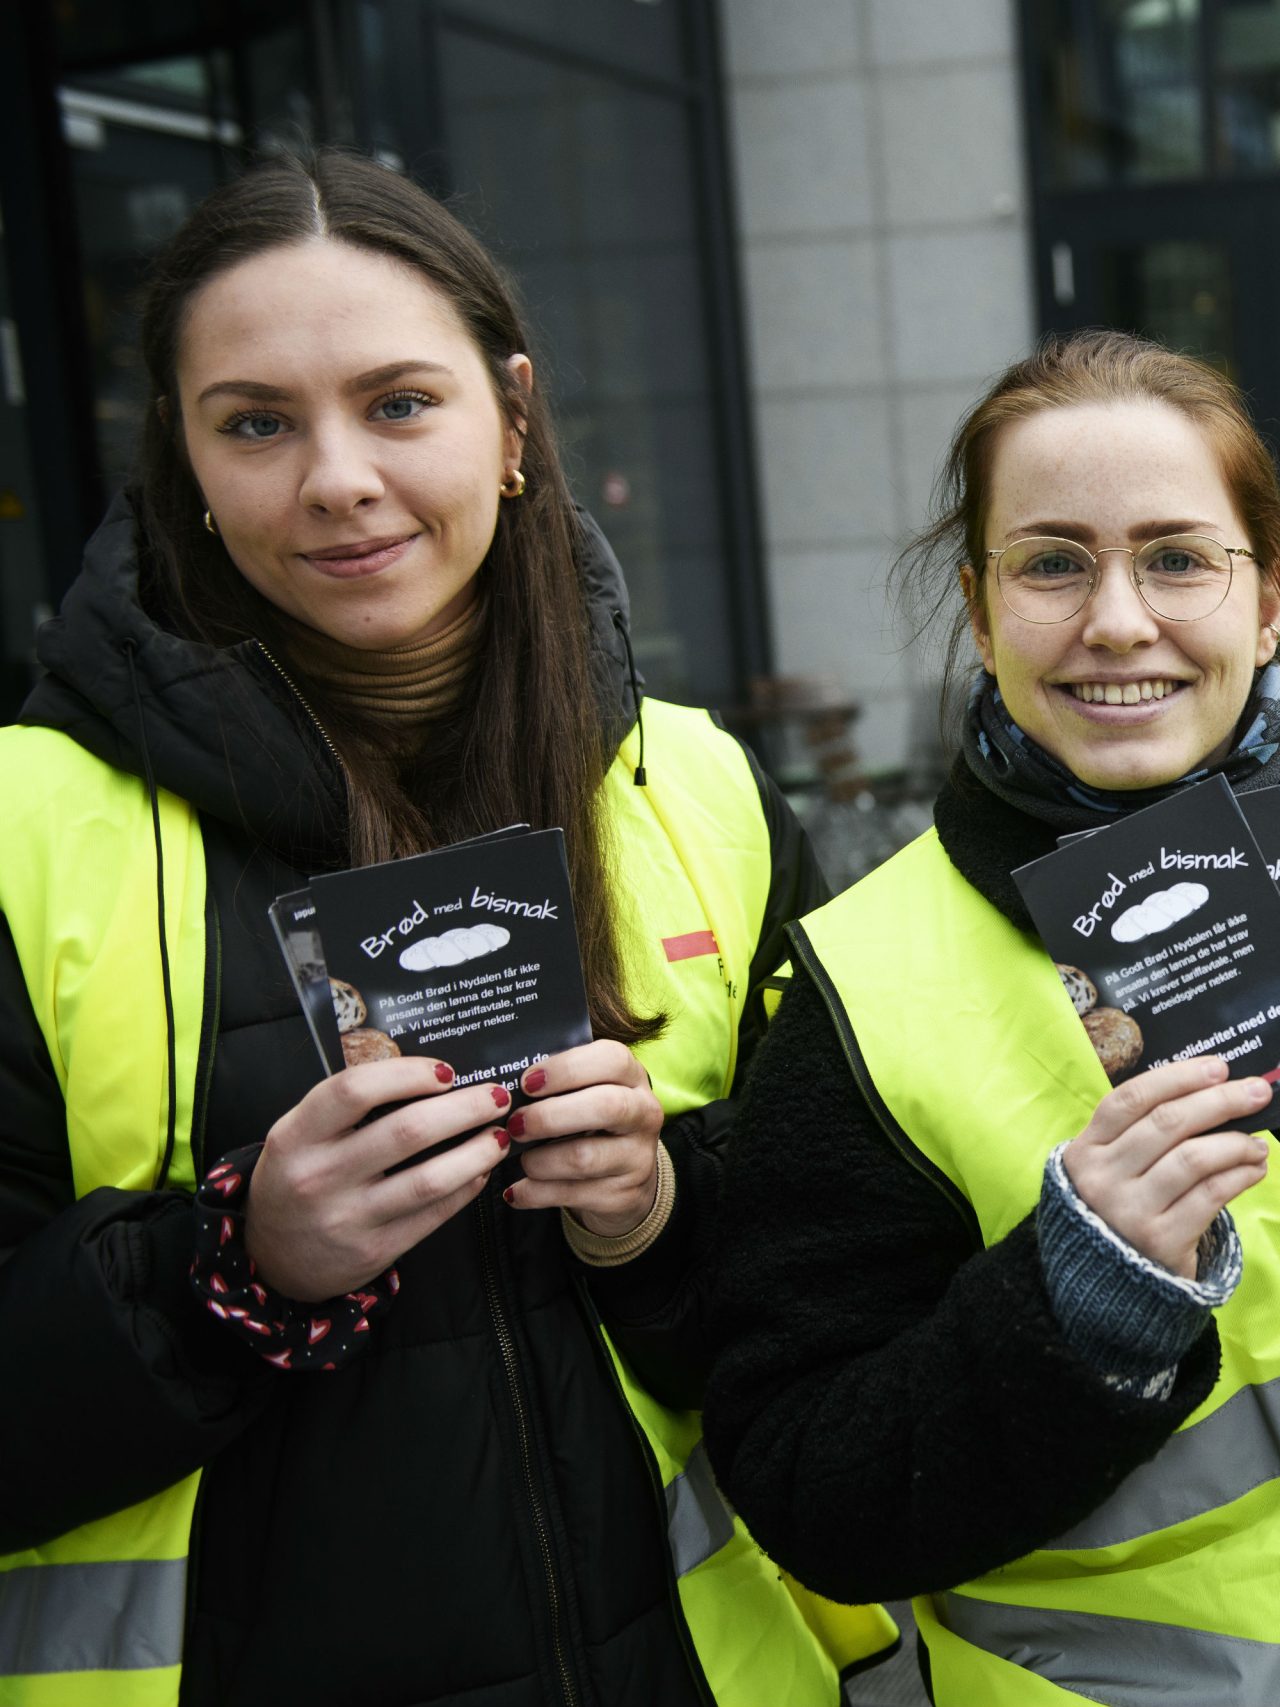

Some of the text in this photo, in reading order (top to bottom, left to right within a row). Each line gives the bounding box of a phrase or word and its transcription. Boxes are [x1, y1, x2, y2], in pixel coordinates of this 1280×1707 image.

[1073, 873, 1127, 938] Brød
[1129, 862, 1155, 884] med
[1160, 847, 1249, 870] bismak
[360, 886, 558, 958] Brød med bismak
[1105, 913, 1248, 985] På Godt Brød i Nydalen får ikke
[1115, 929, 1249, 998] ansatte den lønna de har krav
[379, 997, 395, 1008] På
[398, 991, 423, 1004] Godt
[426, 984, 451, 997] Brød
[460, 973, 501, 989] Nydalen
[504, 968, 517, 979] får
[520, 963, 540, 975] ikke
[386, 978, 537, 1022] ansatte den lønna de har krav
[1122, 943, 1255, 1013] på. Vi krever tariffavtale, men
[1151, 967, 1241, 1015] arbeidsgiver nekter.
[390, 993, 538, 1038] på. Vi krever tariffavtale, men
[419, 1012, 518, 1044] arbeidsgiver nekter.
[1172, 1025, 1238, 1061] solidaritet
[1238, 1014, 1266, 1034] med
[453, 1067, 496, 1087] daritet
[500, 1056, 529, 1074] med
